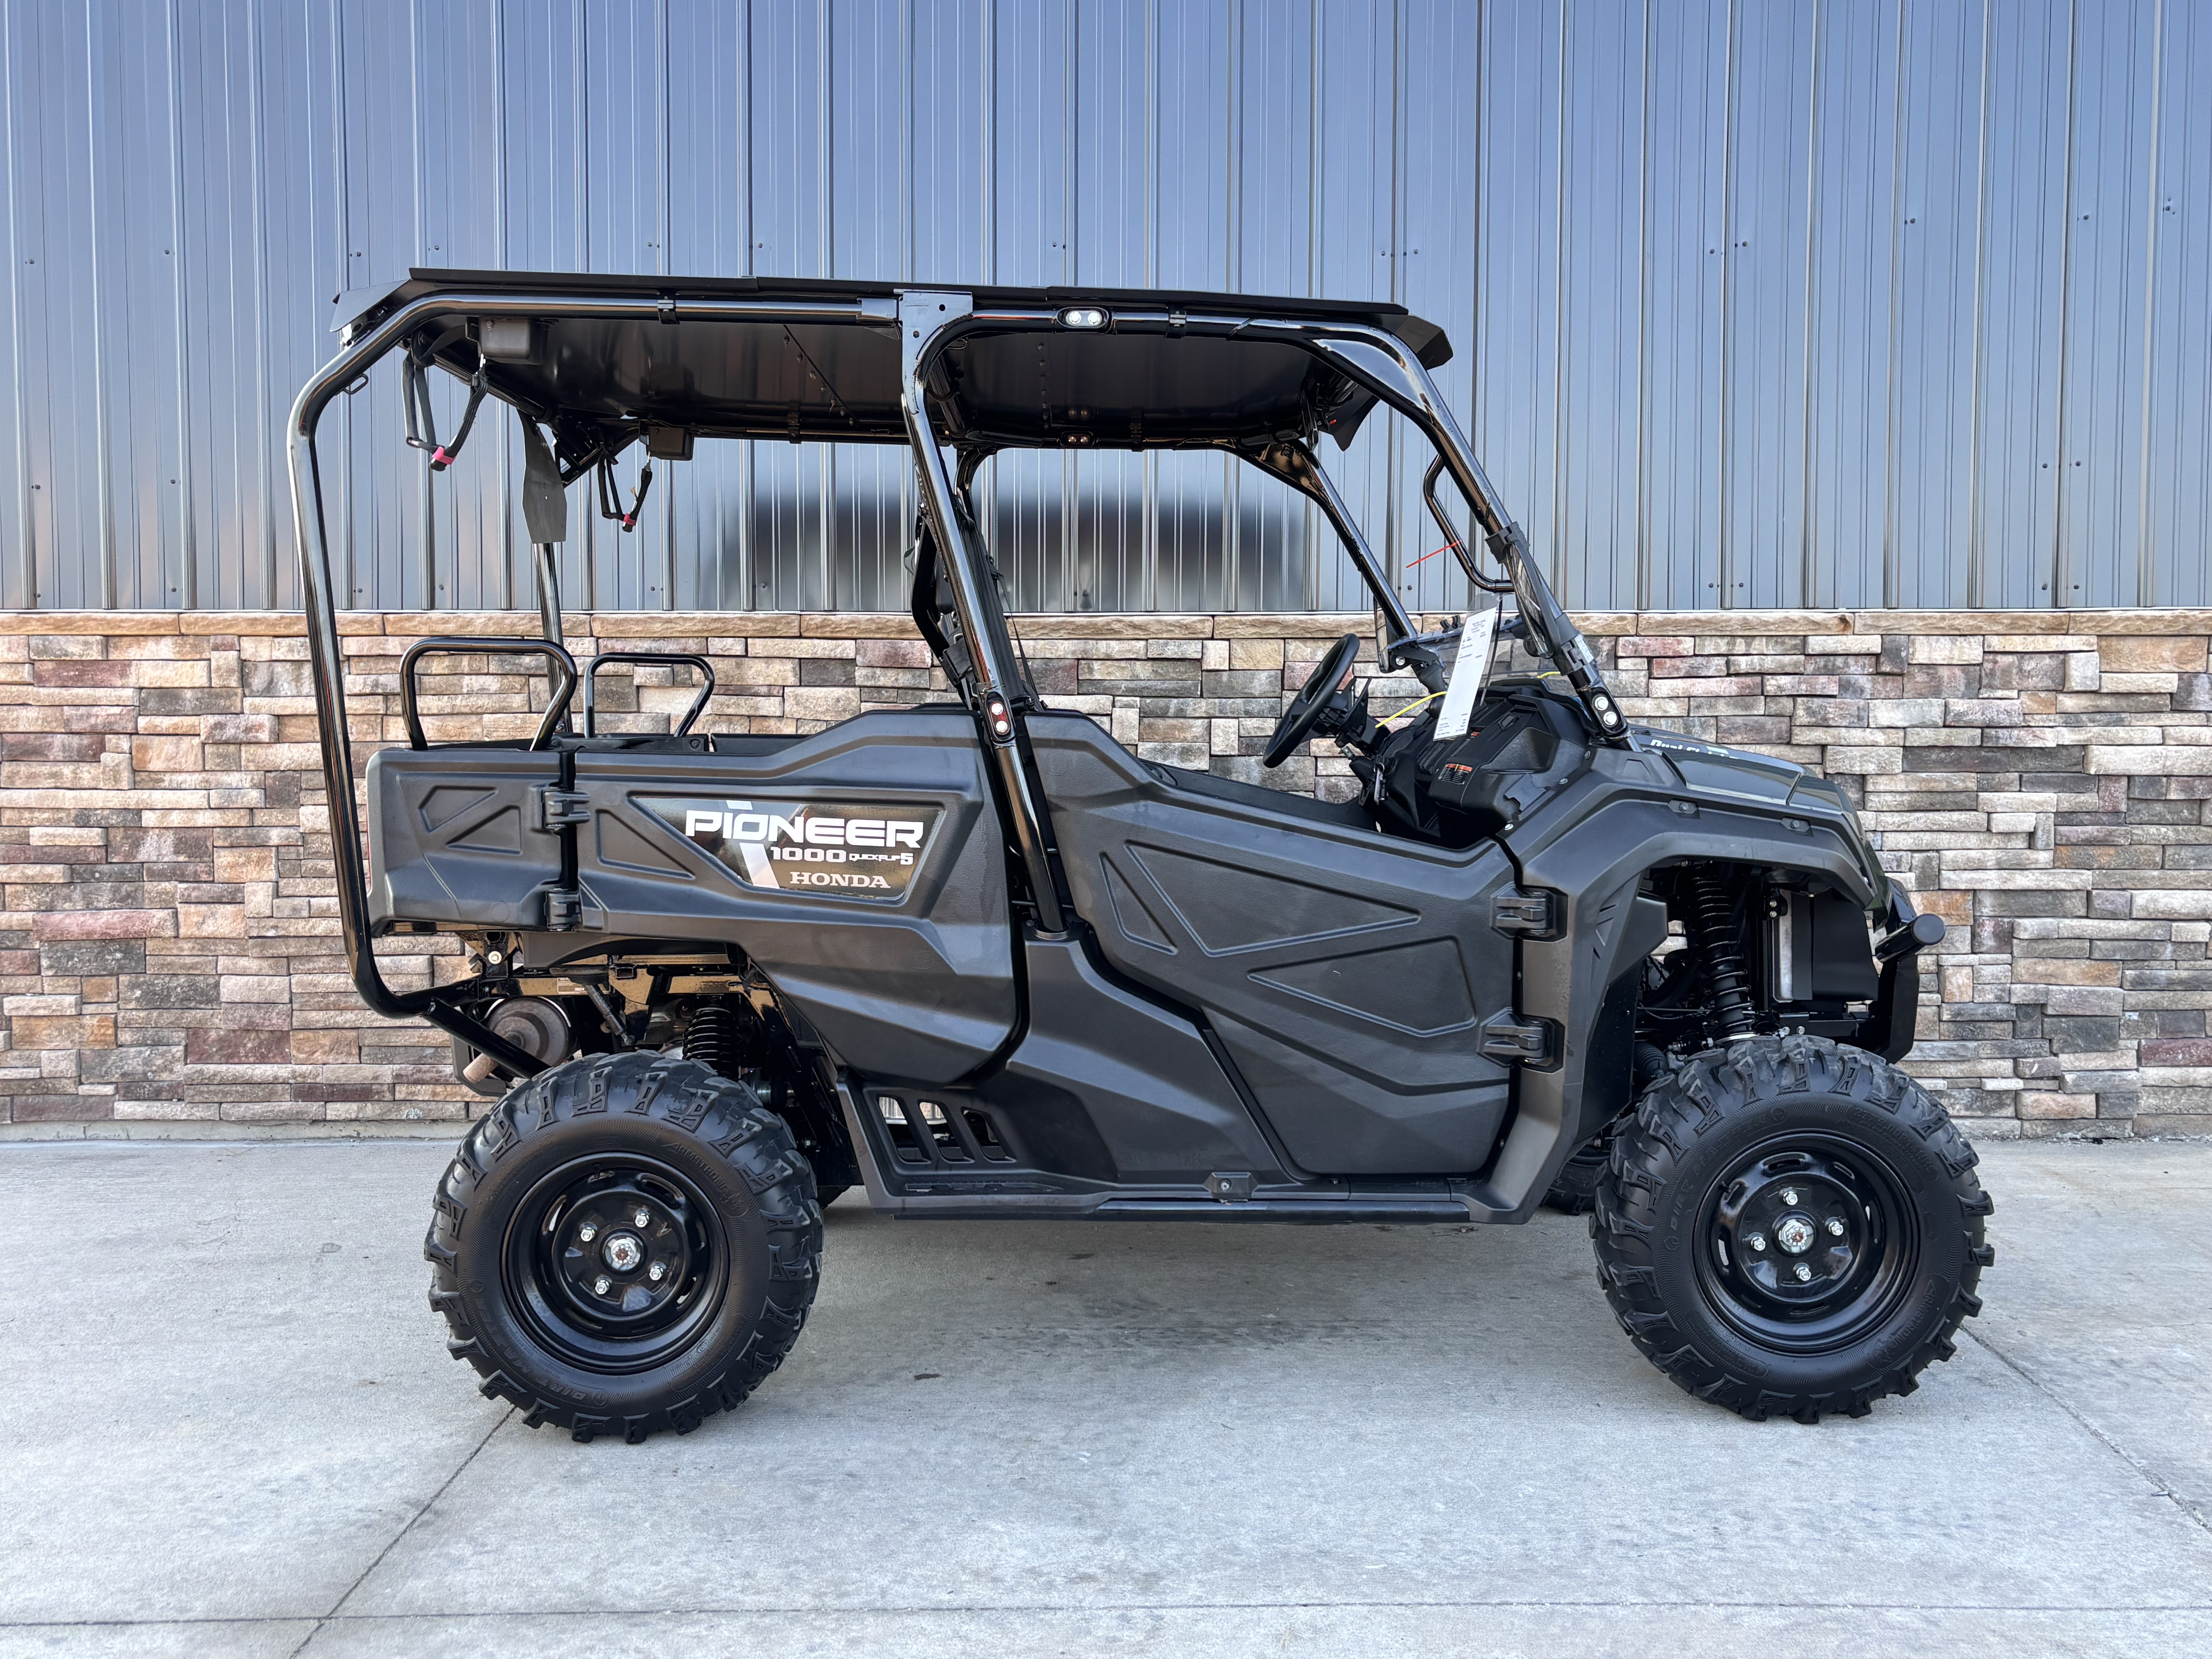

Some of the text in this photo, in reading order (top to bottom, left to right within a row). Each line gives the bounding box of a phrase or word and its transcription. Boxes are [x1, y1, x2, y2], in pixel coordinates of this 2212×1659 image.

[685, 809, 924, 848] PIONEER
[770, 847, 847, 863] 1000
[790, 871, 891, 889] HONDA
[661, 1142, 731, 1194] ARMSTRONG
[1887, 1279, 1937, 1350] ARMSTRONG
[476, 1298, 533, 1374] MASTER
[535, 1377, 587, 1400] DIRT
